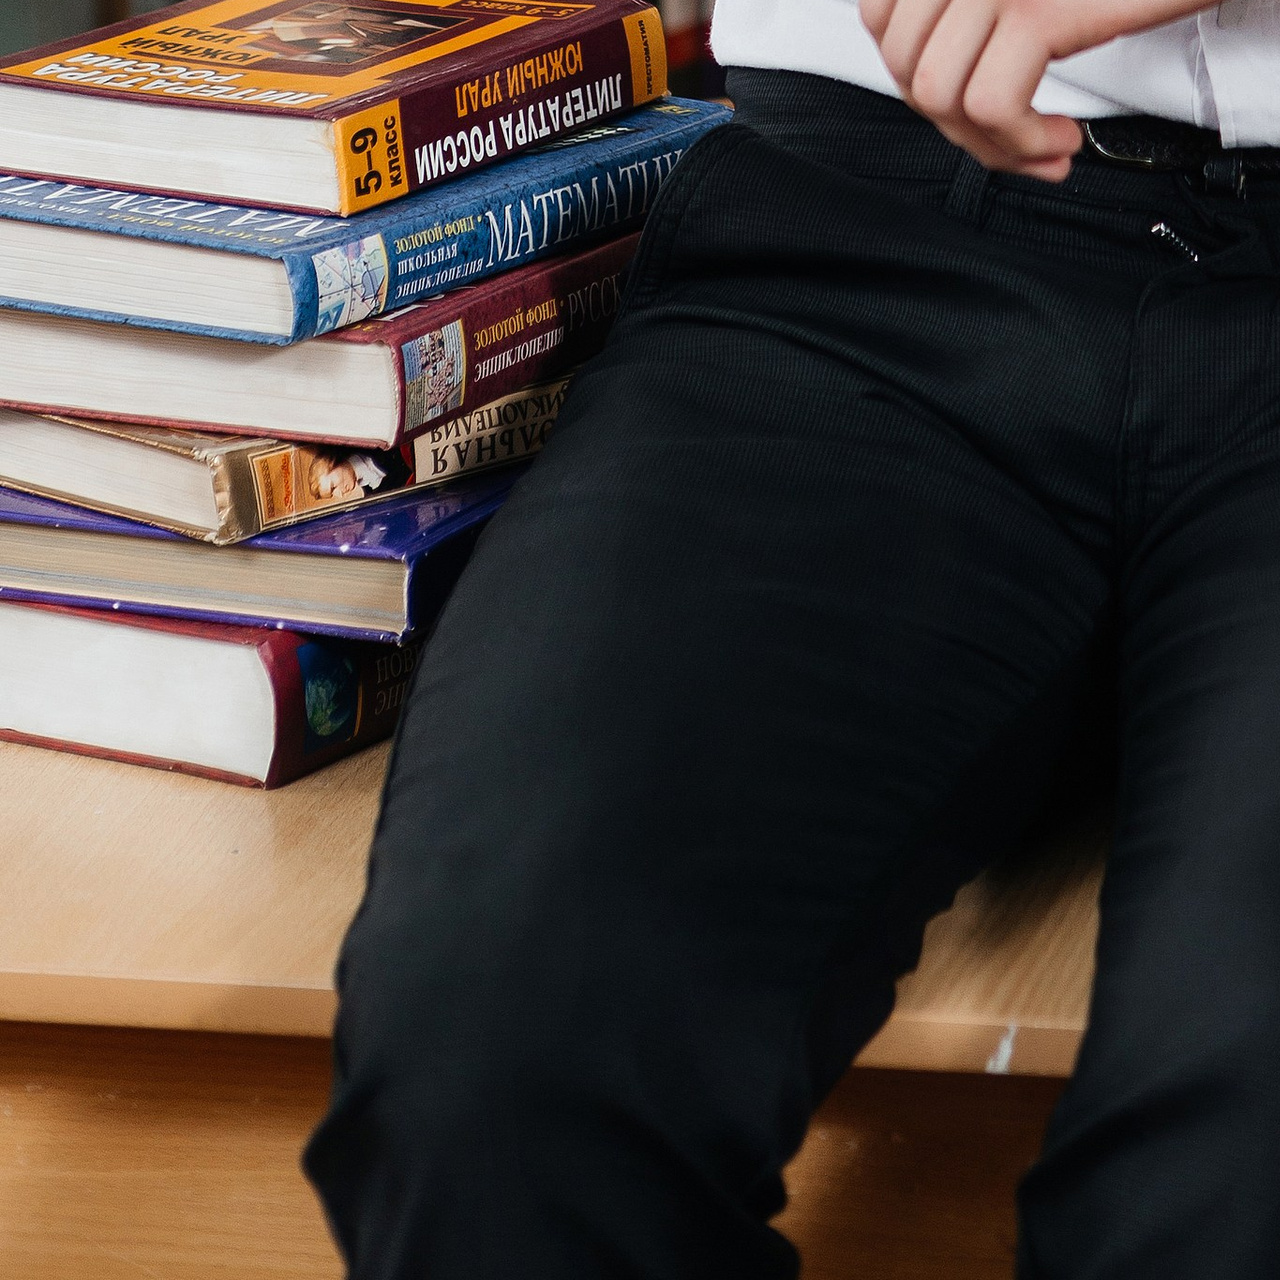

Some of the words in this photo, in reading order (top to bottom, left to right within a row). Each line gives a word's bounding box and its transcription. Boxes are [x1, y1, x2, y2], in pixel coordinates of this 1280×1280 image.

[119, 37, 262, 63] ЮЖНЫЙ
[158, 25, 247, 44] УРАЛ
[31, 62, 332, 106] ЛИТЕРАТУРА
[65, 52, 245, 83] РОССИИ
[507, 40, 585, 105] ЮЖНЫЙ
[455, 66, 501, 119] УРАЛ
[499, 72, 622, 151] ЛИТЕРАТУРА
[382, 114, 403, 189] класс
[414, 119, 498, 185] РОССИИ
[394, 223, 443, 256] ЗОЛОТОЙ
[443, 214, 475, 239] ФОНД
[397, 242, 458, 276] ШКОЛЬНАЯ
[394, 258, 483, 300] ЭНЦИКЛОПЕДИЯ
[472, 309, 525, 352] ЗОЛОТОЙ
[525, 297, 559, 328] ФОНД
[473, 324, 565, 384] ЭНЦИКЛОПЕДИЯ
